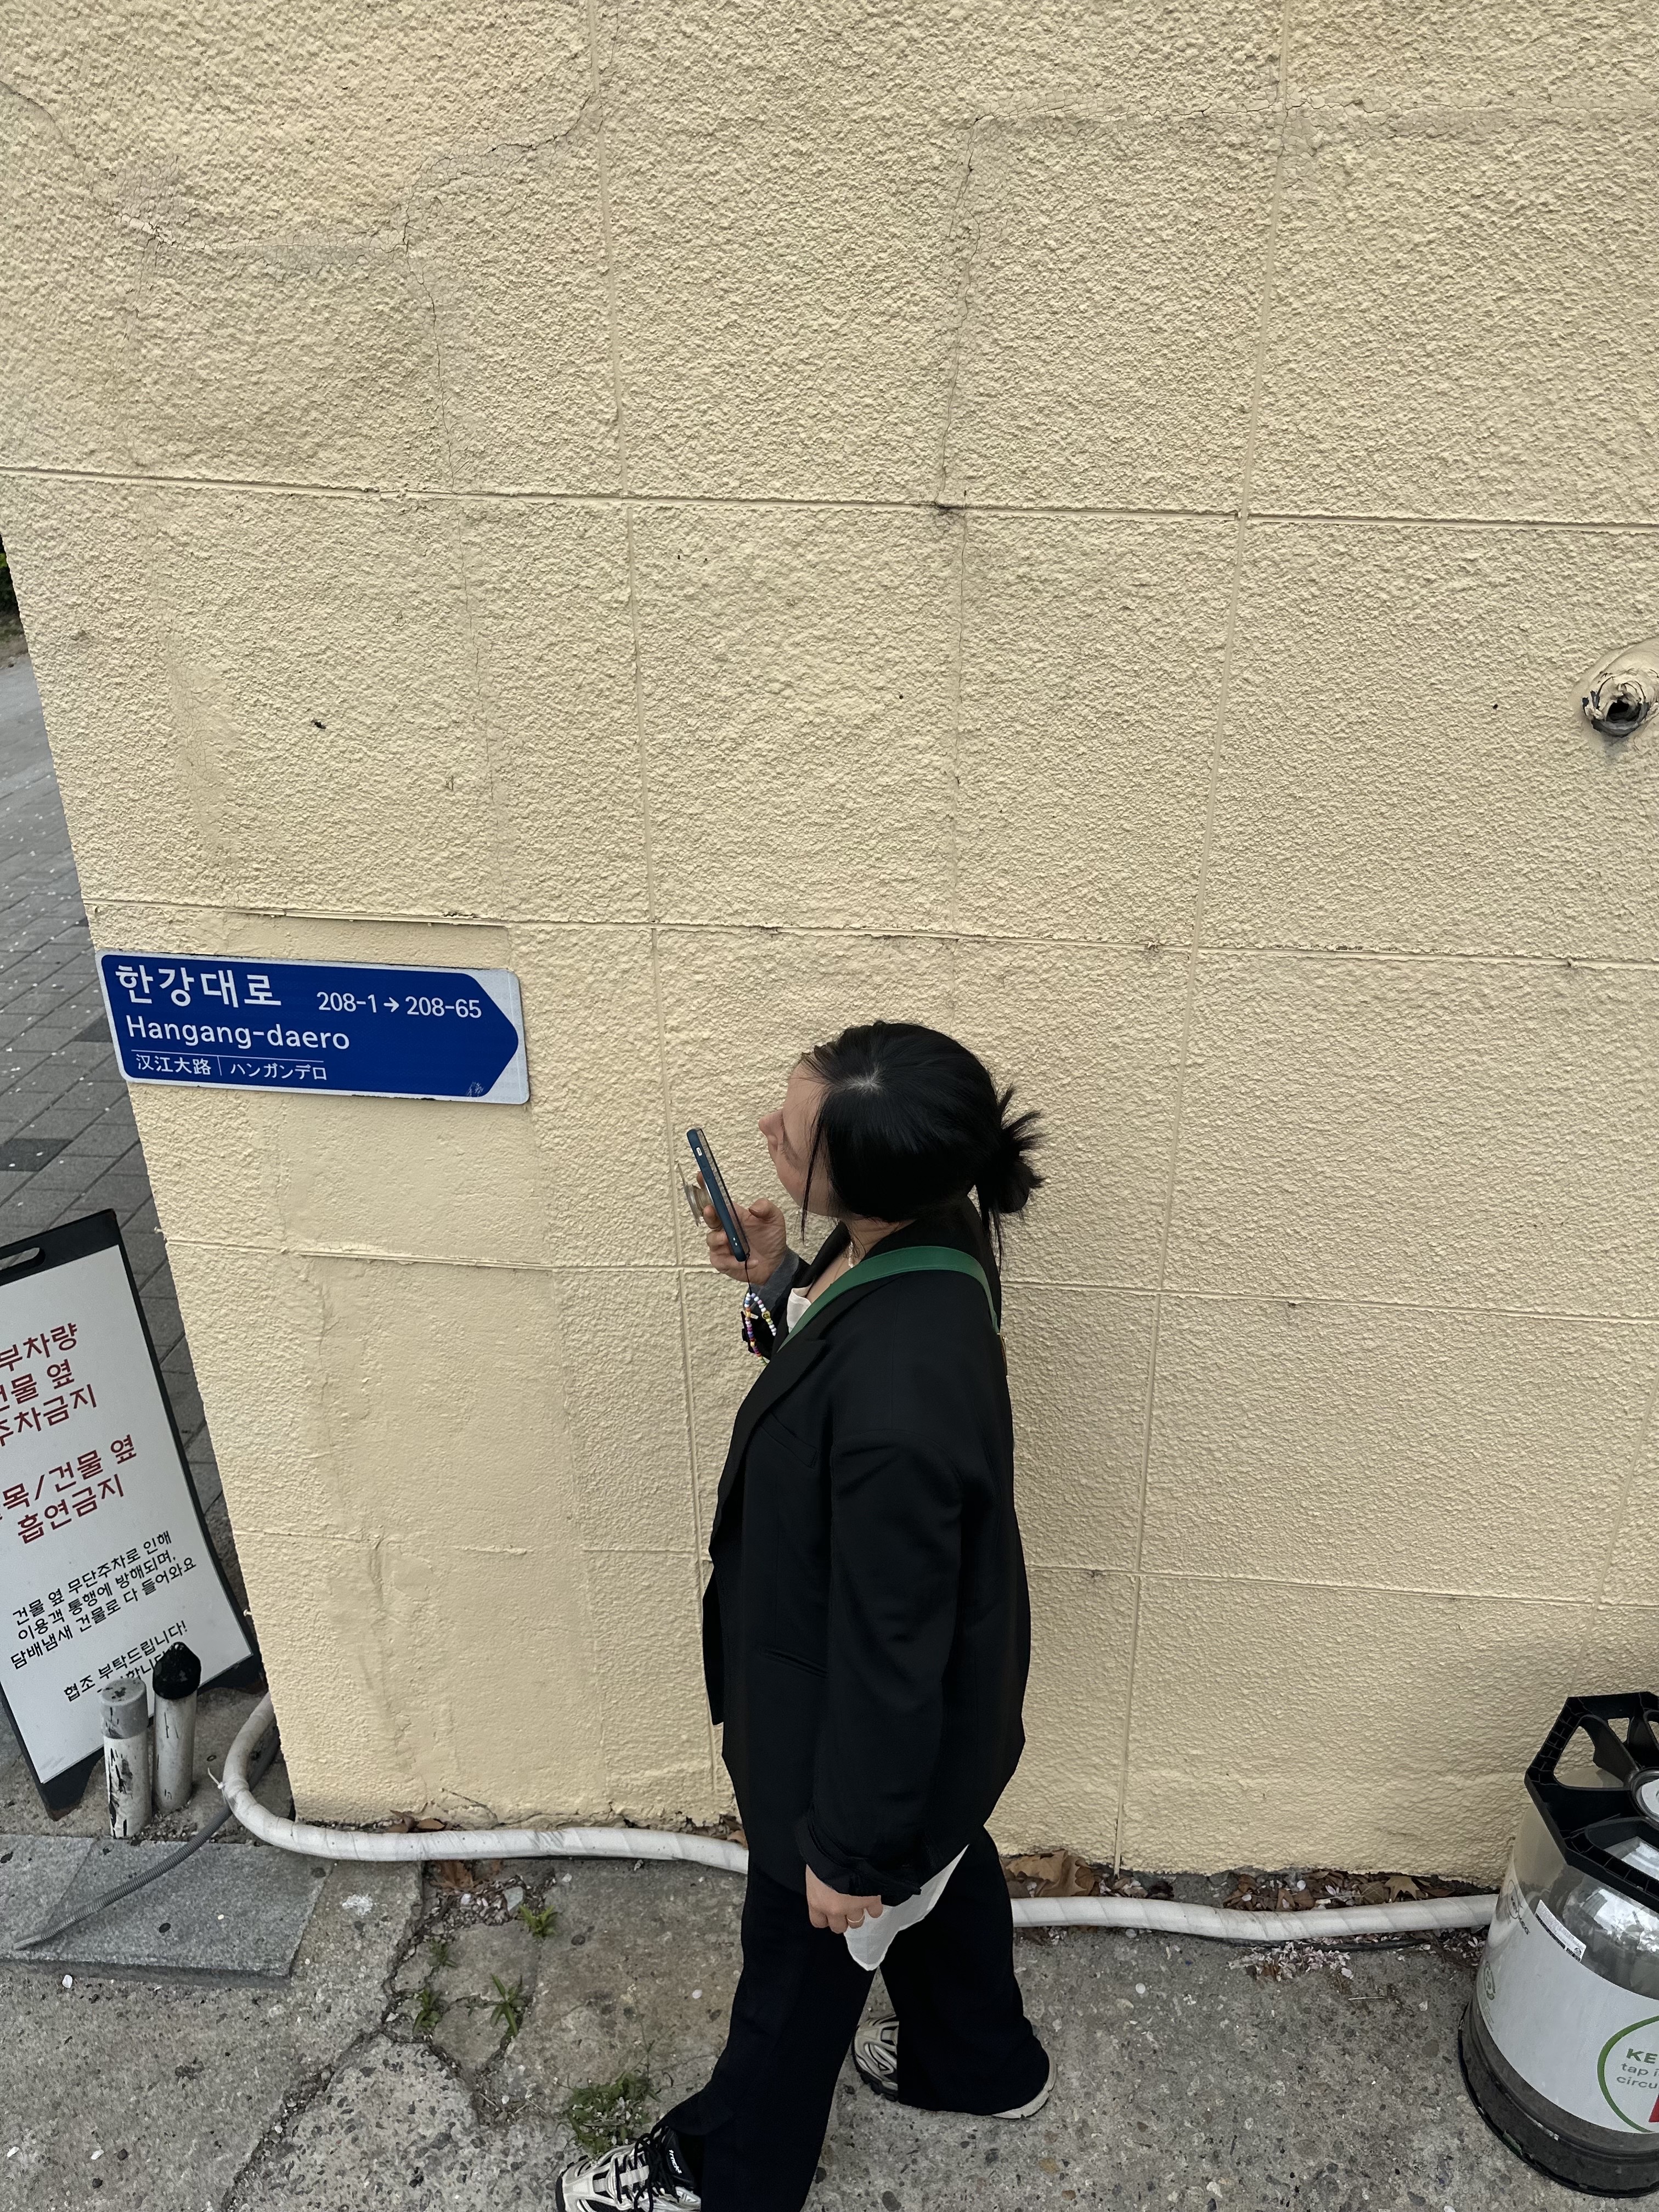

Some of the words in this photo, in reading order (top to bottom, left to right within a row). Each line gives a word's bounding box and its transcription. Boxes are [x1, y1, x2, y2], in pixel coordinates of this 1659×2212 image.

[115, 964, 281, 1008] 한강대로
[317, 991, 377, 1013] 208-1
[405, 996, 482, 1018] 208-65
[126, 1015, 349, 1049] Hangang-daero
[136, 1054, 211, 1075] 汉江大路
[230, 1063, 326, 1080] ハンガンデロ
[47, 1358, 75, 1390] 옆
[0, 1449, 103, 1520] 목/건물
[110, 1434, 137, 1464] 옆
[18, 1474, 124, 1544] 흡연금지
[13, 1599, 45, 1626] 건물
[48, 1588, 65, 1607] 옆
[67, 1548, 141, 1594] 무단주차로
[143, 1531, 172, 1555] 인해
[18, 1609, 65, 1640] 이용객
[69, 1582, 112, 1616] 통행에
[115, 1550, 176, 1589] 방해되며,
[10, 1624, 74, 1670] 담배냄새
[76, 1599, 121, 1633] 건물로
[123, 1588, 138, 1602] 다
[142, 1557, 196, 1596] 들어와요
[64, 1674, 95, 1702] 협조
[98, 1620, 188, 1679] 부탁드립니다!
[1616, 2076, 1658, 2089] circu
[1621, 2063, 1649, 2076] tap
[1626, 2048, 1658, 2064] KE
